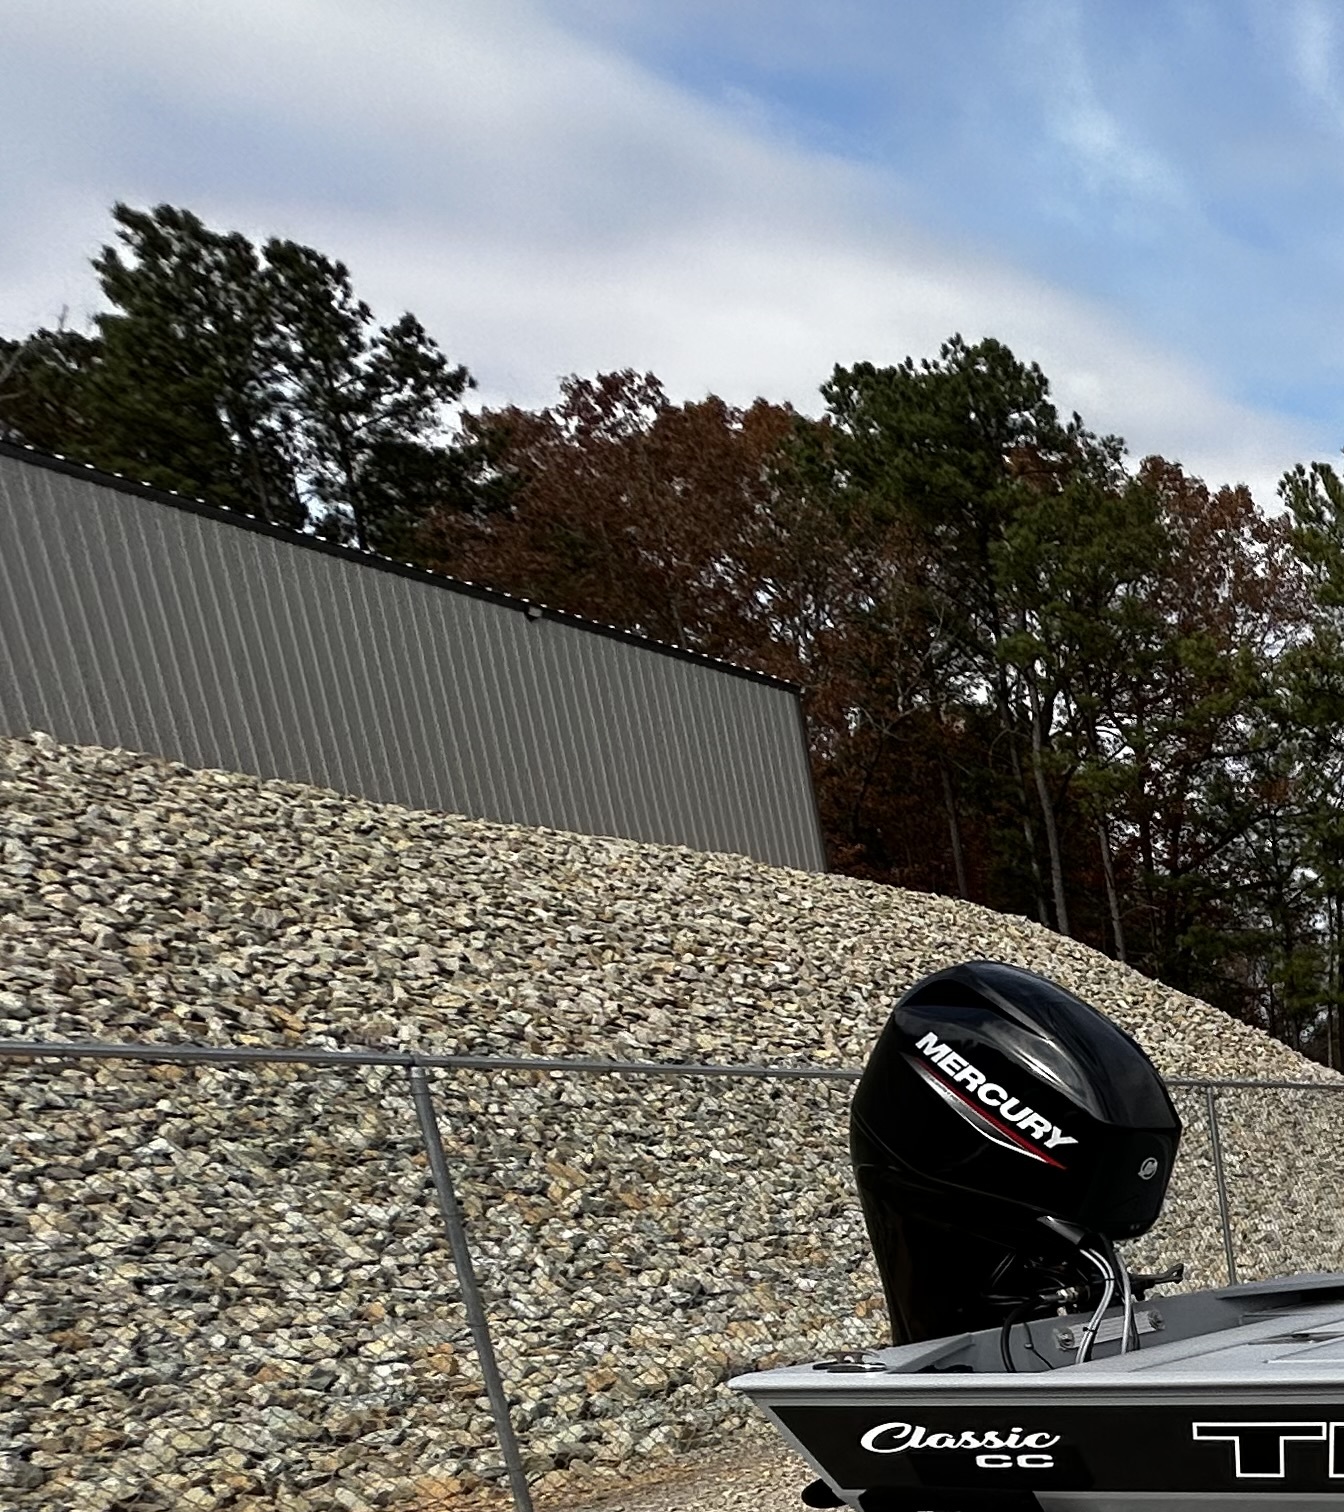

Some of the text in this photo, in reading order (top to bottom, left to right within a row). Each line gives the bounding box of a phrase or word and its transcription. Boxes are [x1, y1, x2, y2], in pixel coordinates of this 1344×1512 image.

[915, 1032, 1079, 1149] MERCURY
[860, 1422, 1061, 1453] Classic
[975, 1454, 1055, 1468] CC
